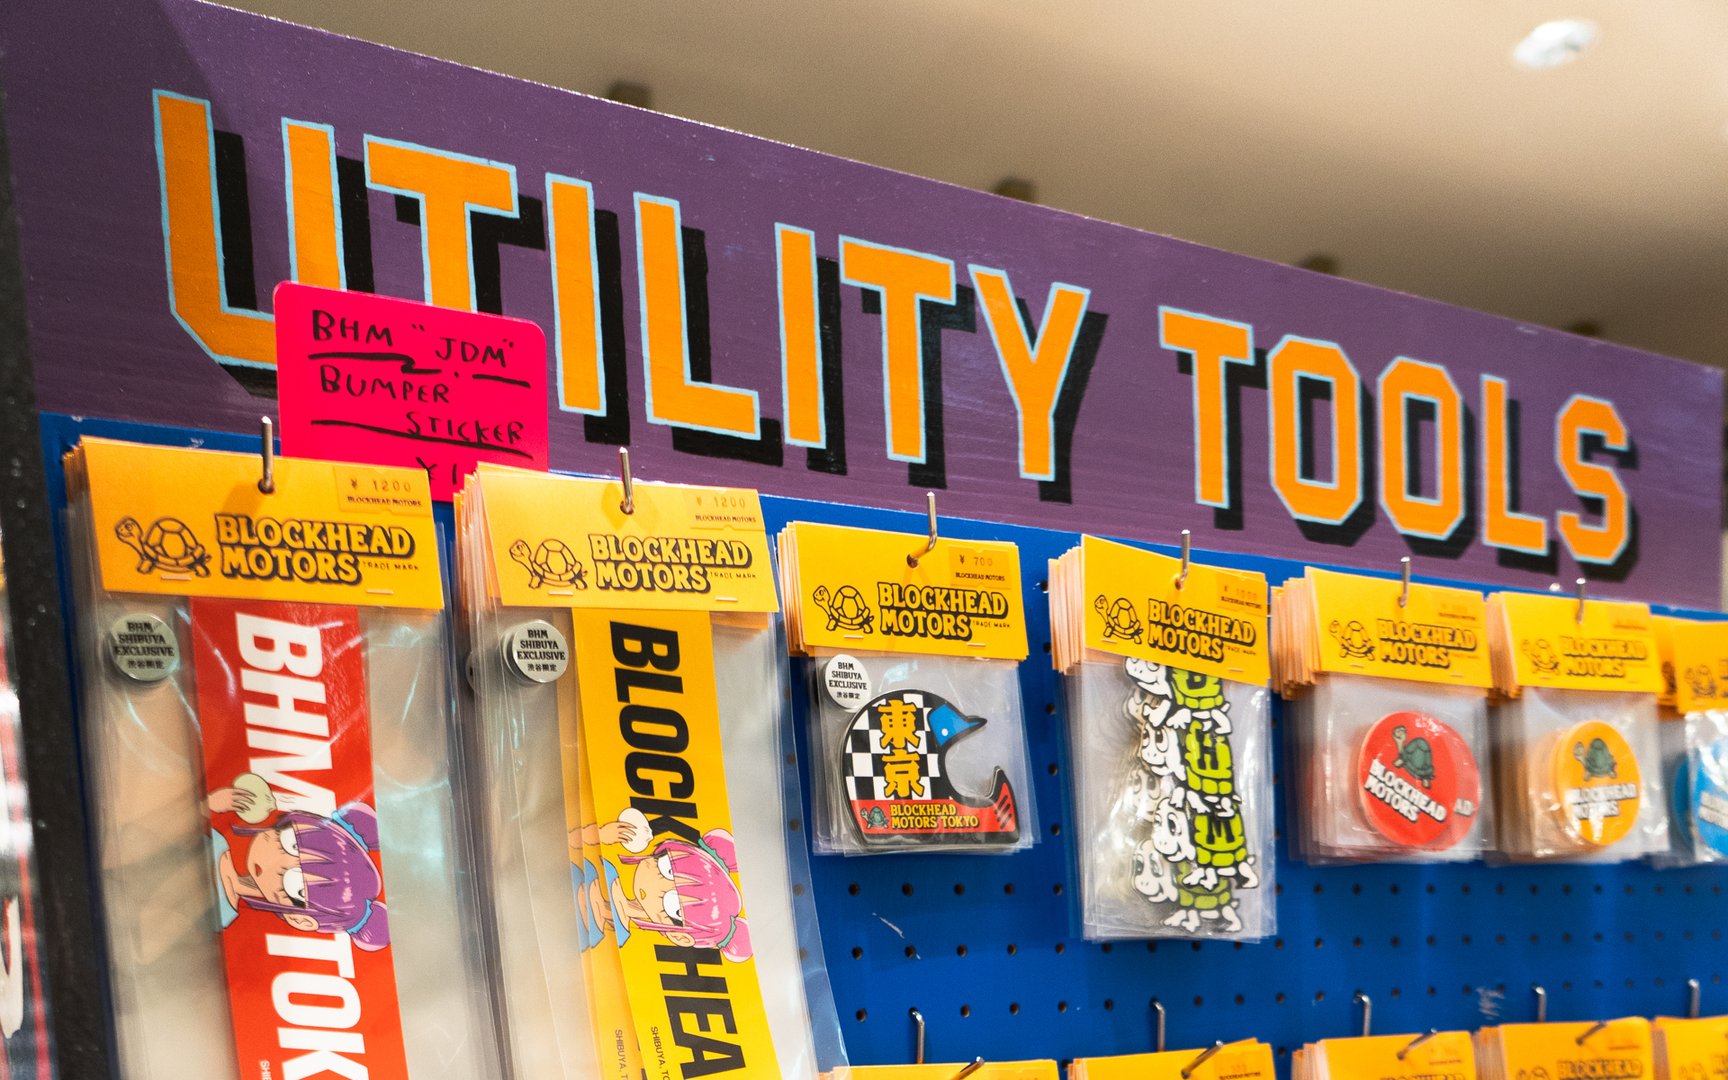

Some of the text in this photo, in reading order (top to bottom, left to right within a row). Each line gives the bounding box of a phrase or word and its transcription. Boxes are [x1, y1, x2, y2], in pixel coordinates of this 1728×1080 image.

[153, 88, 1630, 565] UTILITY TOOLS
[312, 309, 393, 347] BHM
[320, 365, 449, 403] BUMPER
[405, 411, 524, 444] STICKER
[372, 478, 412, 492] 1200
[214, 514, 416, 559] BLOCKHEAD
[587, 533, 752, 568] BLOCKHEAD
[220, 545, 362, 586] MOTORS
[595, 560, 711, 594] MOTORS
[877, 581, 1008, 619] BLOCKHEAD
[127, 622, 154, 633] BHM
[527, 629, 549, 639] BHM
[880, 607, 972, 641] MOTORS
[1147, 599, 1256, 647] BLOCKHEAD
[1376, 618, 1478, 651] BLOCKHEAD
[114, 646, 175, 656] EXCLUSIVE
[516, 651, 566, 662] EXCLUSIVE
[520, 640, 559, 650] SHIBUYA
[1147, 629, 1225, 664] MOTORS
[1379, 641, 1451, 669] MOTORS
[831, 671, 862, 681] SHIBUYA
[837, 662, 854, 671] BHM
[828, 680, 867, 690] EXCLUSIVE
[877, 699, 926, 798] 東京
[1363, 773, 1420, 824] MOTORS
[1369, 759, 1447, 823] BLOCKHEAD
[889, 803, 957, 816] BLOCKHEAD
[891, 815, 979, 829] MOTORS TOKYO
